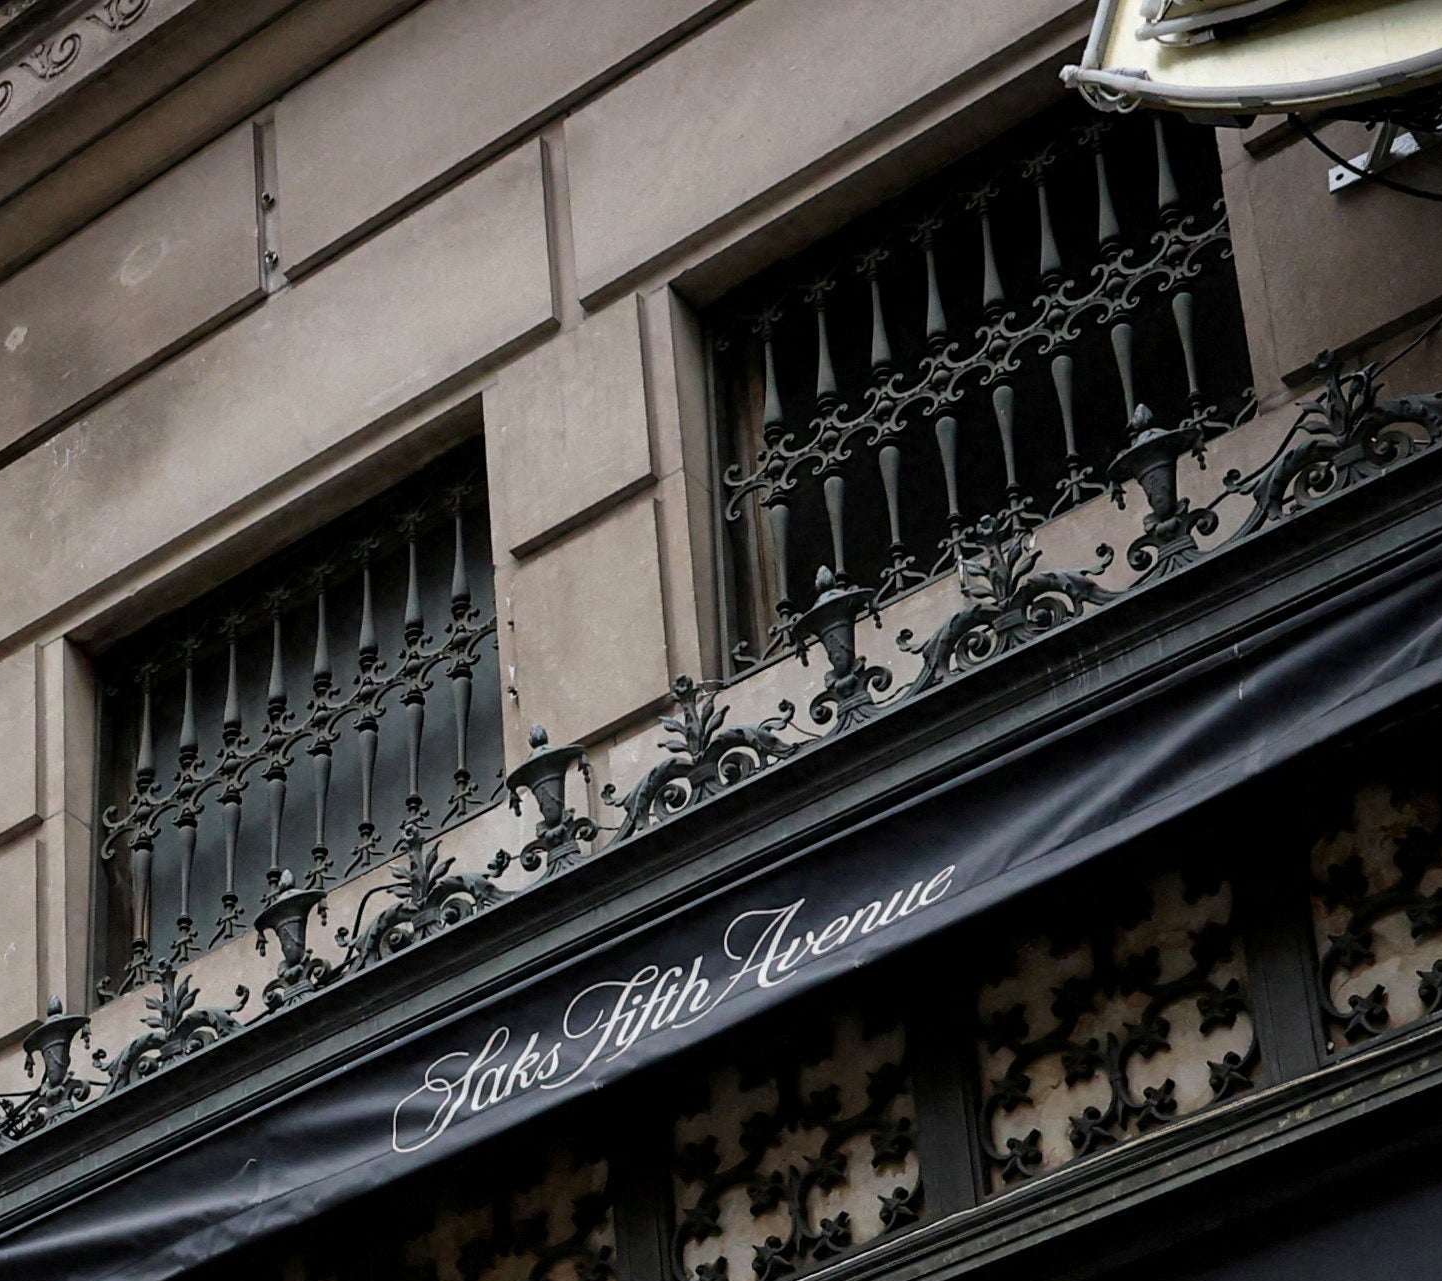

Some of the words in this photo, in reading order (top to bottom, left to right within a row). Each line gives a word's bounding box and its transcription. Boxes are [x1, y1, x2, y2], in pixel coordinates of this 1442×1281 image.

[392, 1026, 561, 1153] Saks
[540, 956, 720, 1089] Fifth
[672, 864, 957, 1029] Avenue
